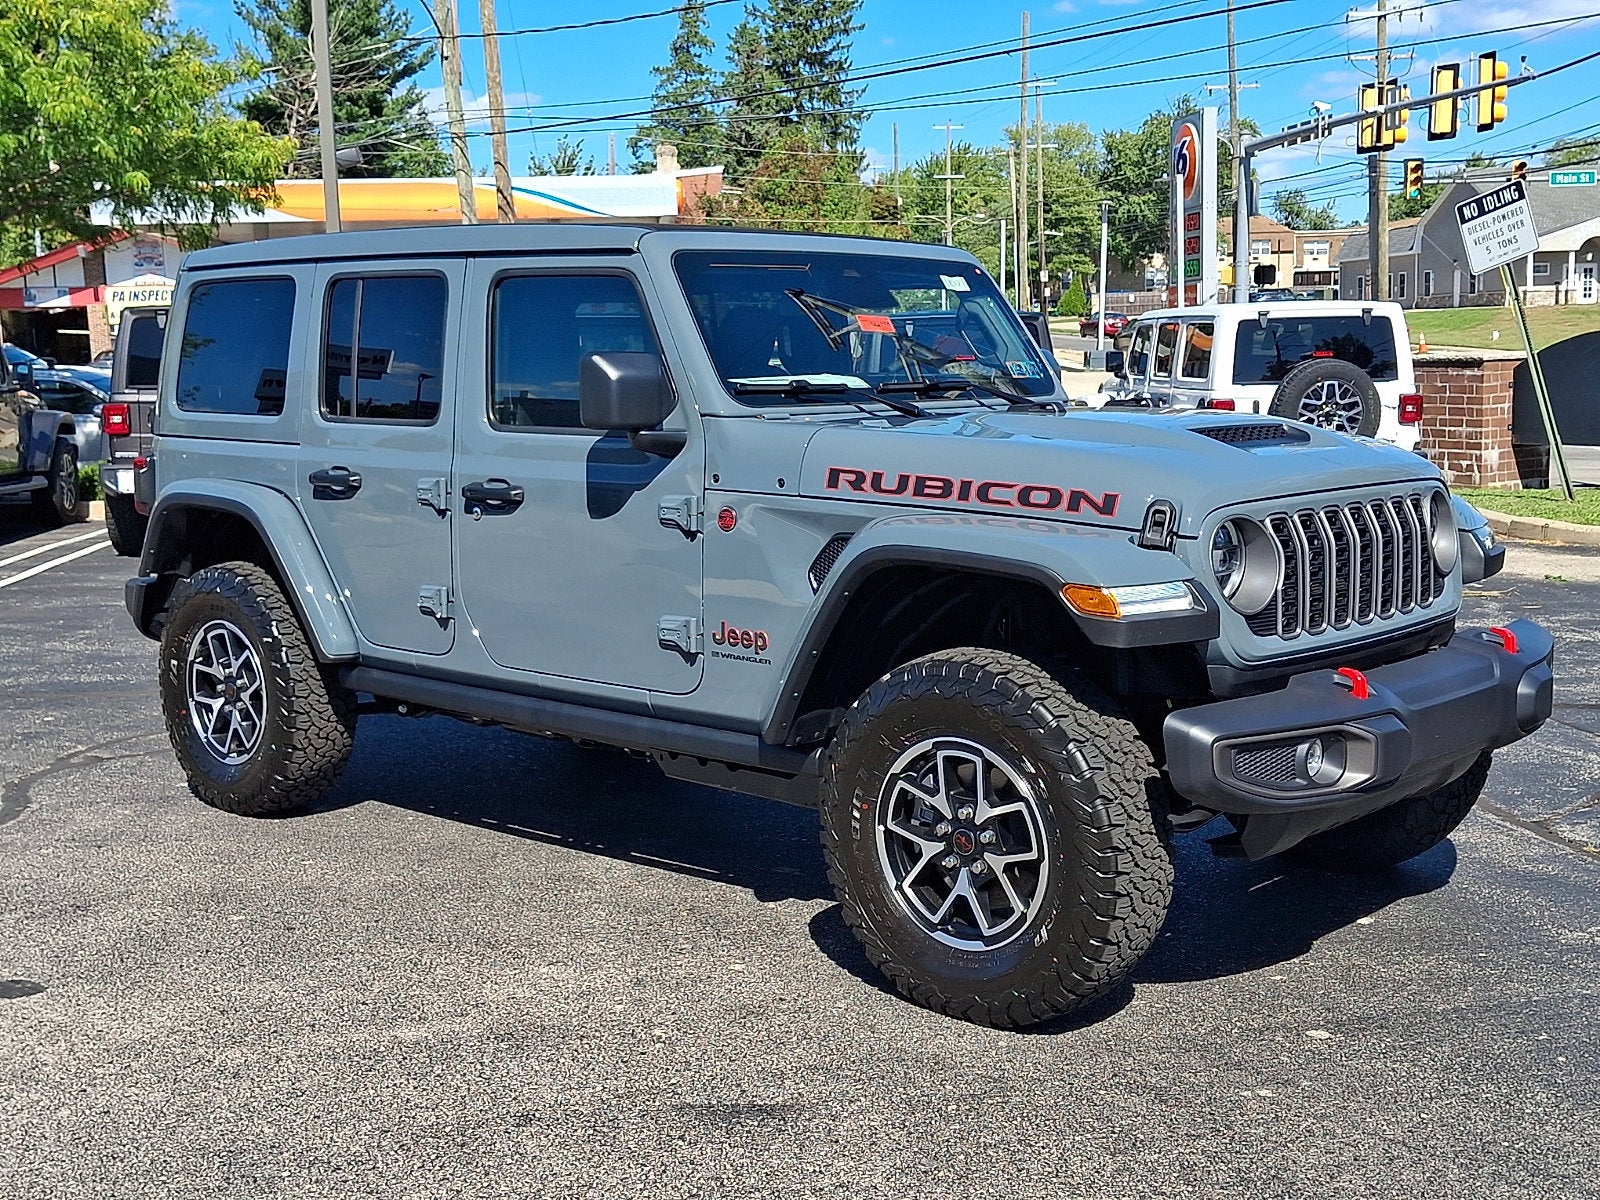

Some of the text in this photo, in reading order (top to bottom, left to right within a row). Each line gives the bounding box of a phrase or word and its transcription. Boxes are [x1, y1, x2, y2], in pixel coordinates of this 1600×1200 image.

[1556, 172, 1590, 184] Main St
[1462, 185, 1519, 220] NO IDLING
[1467, 206, 1524, 236] DIESEL-POWERED
[1473, 219, 1526, 246] VEHICLES OVER
[1485, 246, 1492, 255] 5
[1498, 235, 1519, 250] TONS
[112, 291, 125, 302] PA
[825, 466, 1122, 518] RUBICON
[712, 620, 769, 656] Jeep
[719, 651, 773, 666] WRANGLER
